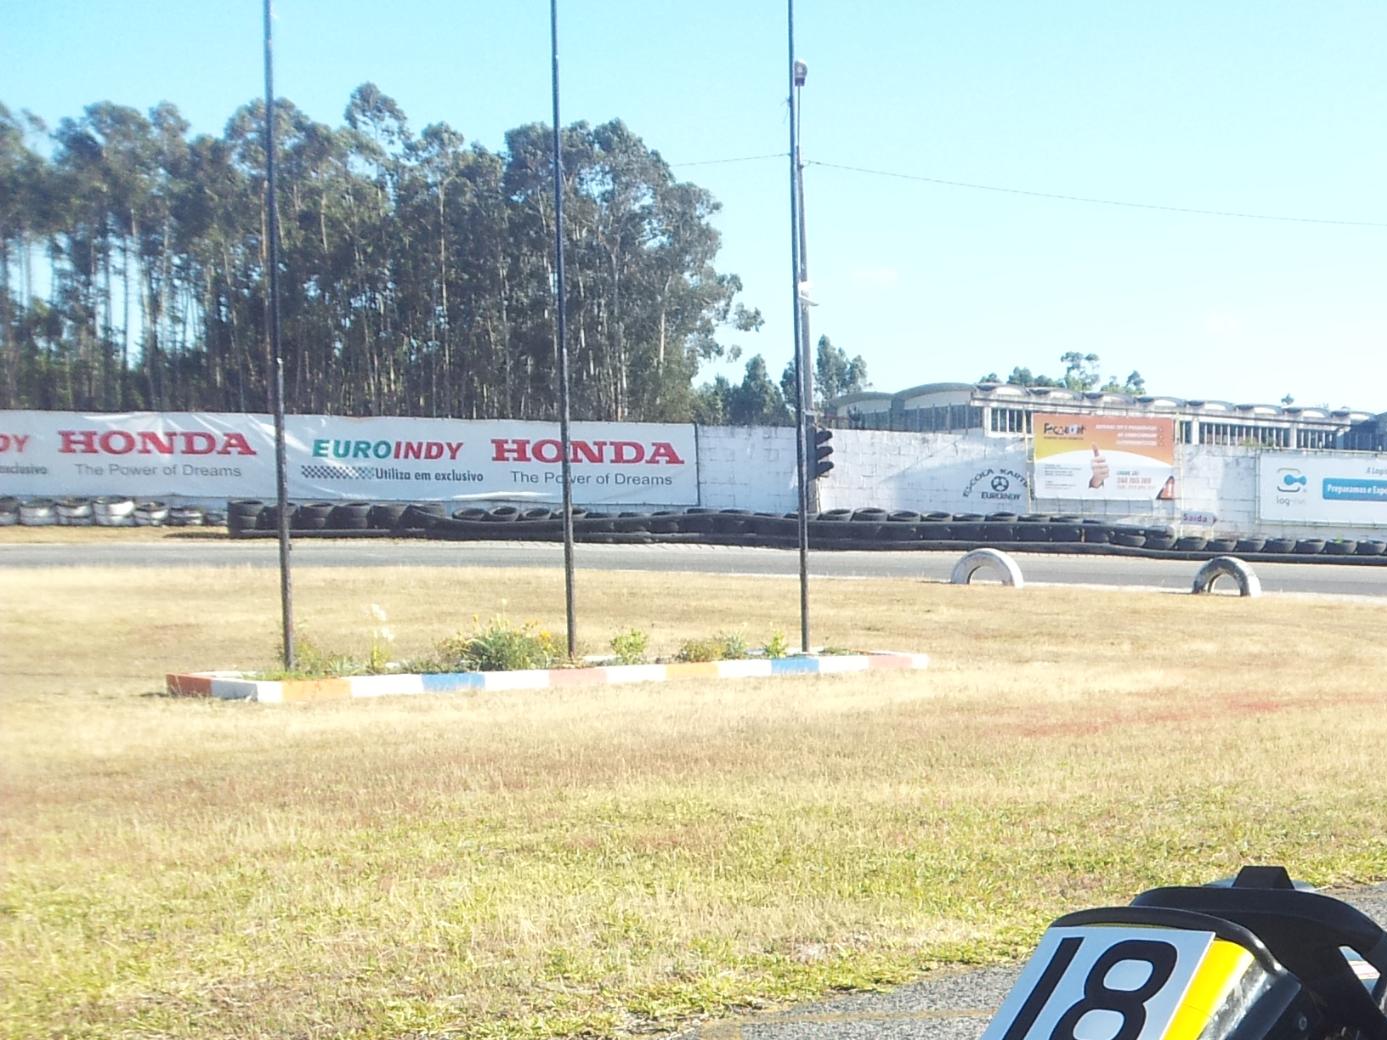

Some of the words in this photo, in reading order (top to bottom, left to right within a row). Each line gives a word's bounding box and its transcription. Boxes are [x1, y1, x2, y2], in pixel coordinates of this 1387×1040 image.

[57, 430, 257, 455] HONDA
[312, 439, 464, 460] EUROINDY
[491, 438, 685, 465] HONDA
[75, 463, 104, 475] The
[109, 463, 157, 476] Power
[163, 463, 178, 476] of
[183, 464, 242, 477] Dreams
[375, 467, 411, 481] Utiliza
[414, 471, 431, 481] em
[434, 468, 484, 482] exclusivo
[511, 470, 539, 484] The
[544, 472, 591, 485] Poer
[596, 473, 610, 485] of
[615, 473, 673, 486] Dreams
[963, 468, 994, 498] ESCOLA
